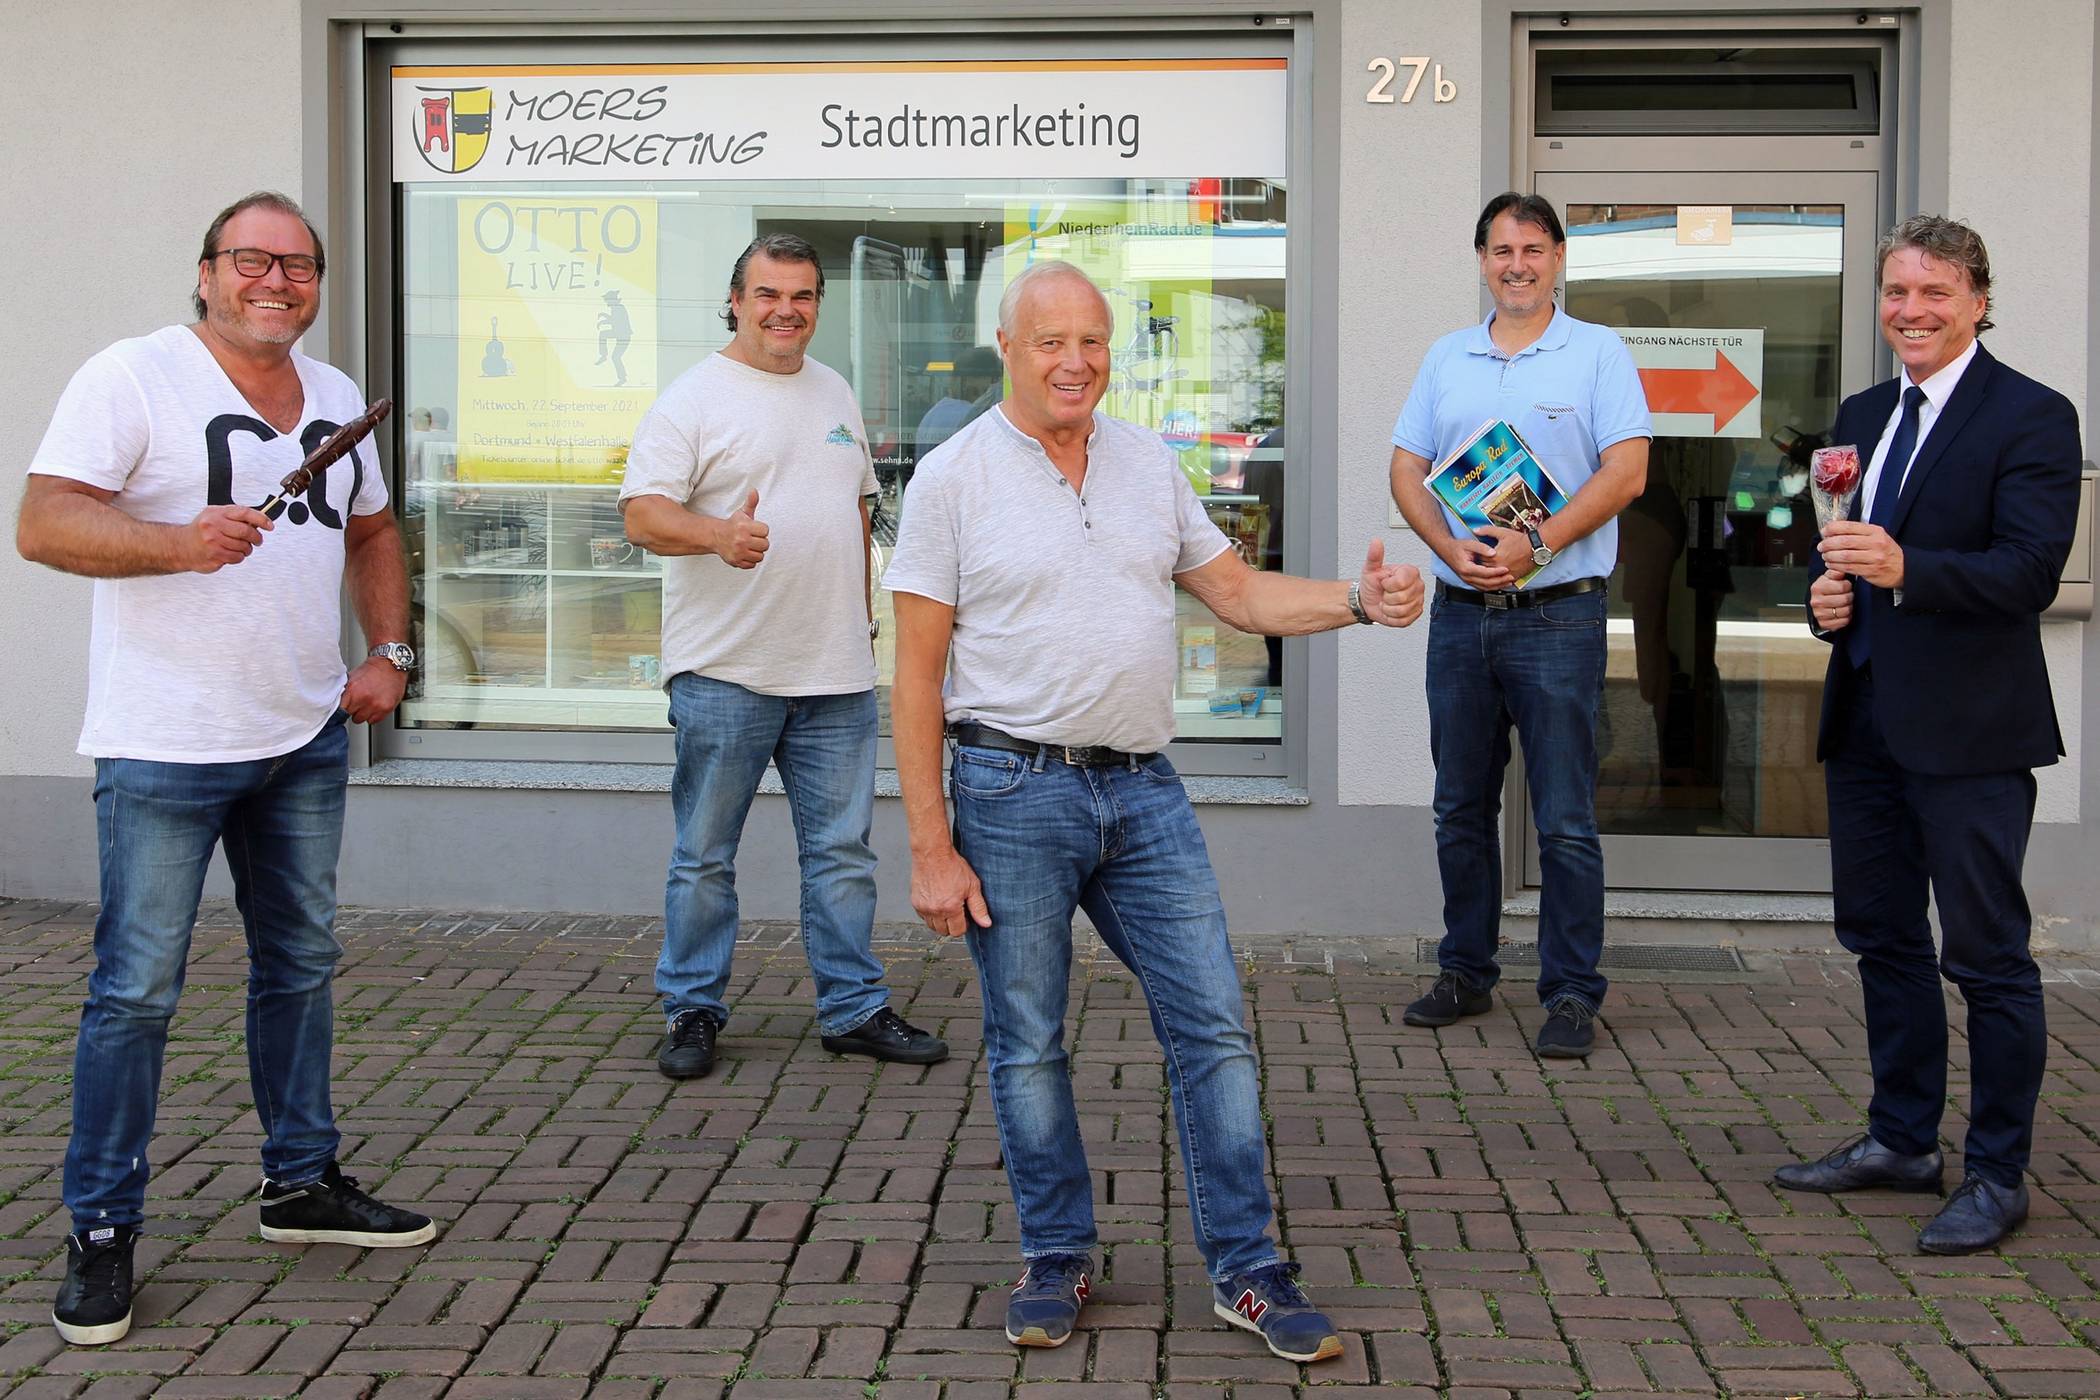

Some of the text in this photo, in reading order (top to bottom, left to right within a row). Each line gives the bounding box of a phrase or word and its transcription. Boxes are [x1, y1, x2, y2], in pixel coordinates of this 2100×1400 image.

[1366, 56, 1457, 104] 27b
[505, 86, 668, 121] MOERS
[821, 103, 1140, 159] Stadtmarketing
[474, 201, 641, 254] OTTO
[1058, 221, 1203, 237] NiederrheinRad.de
[505, 253, 603, 291] LIVE!
[1668, 334, 1719, 347] NÄCHSTE
[1722, 335, 1743, 347] TÜR
[550, 399, 609, 413] September
[473, 432, 629, 448] Dortmund Westfalenhalle
[1452, 460, 1487, 492] Europa
[1487, 438, 1508, 463] Rad
[1234, 1288, 1269, 1325] N
